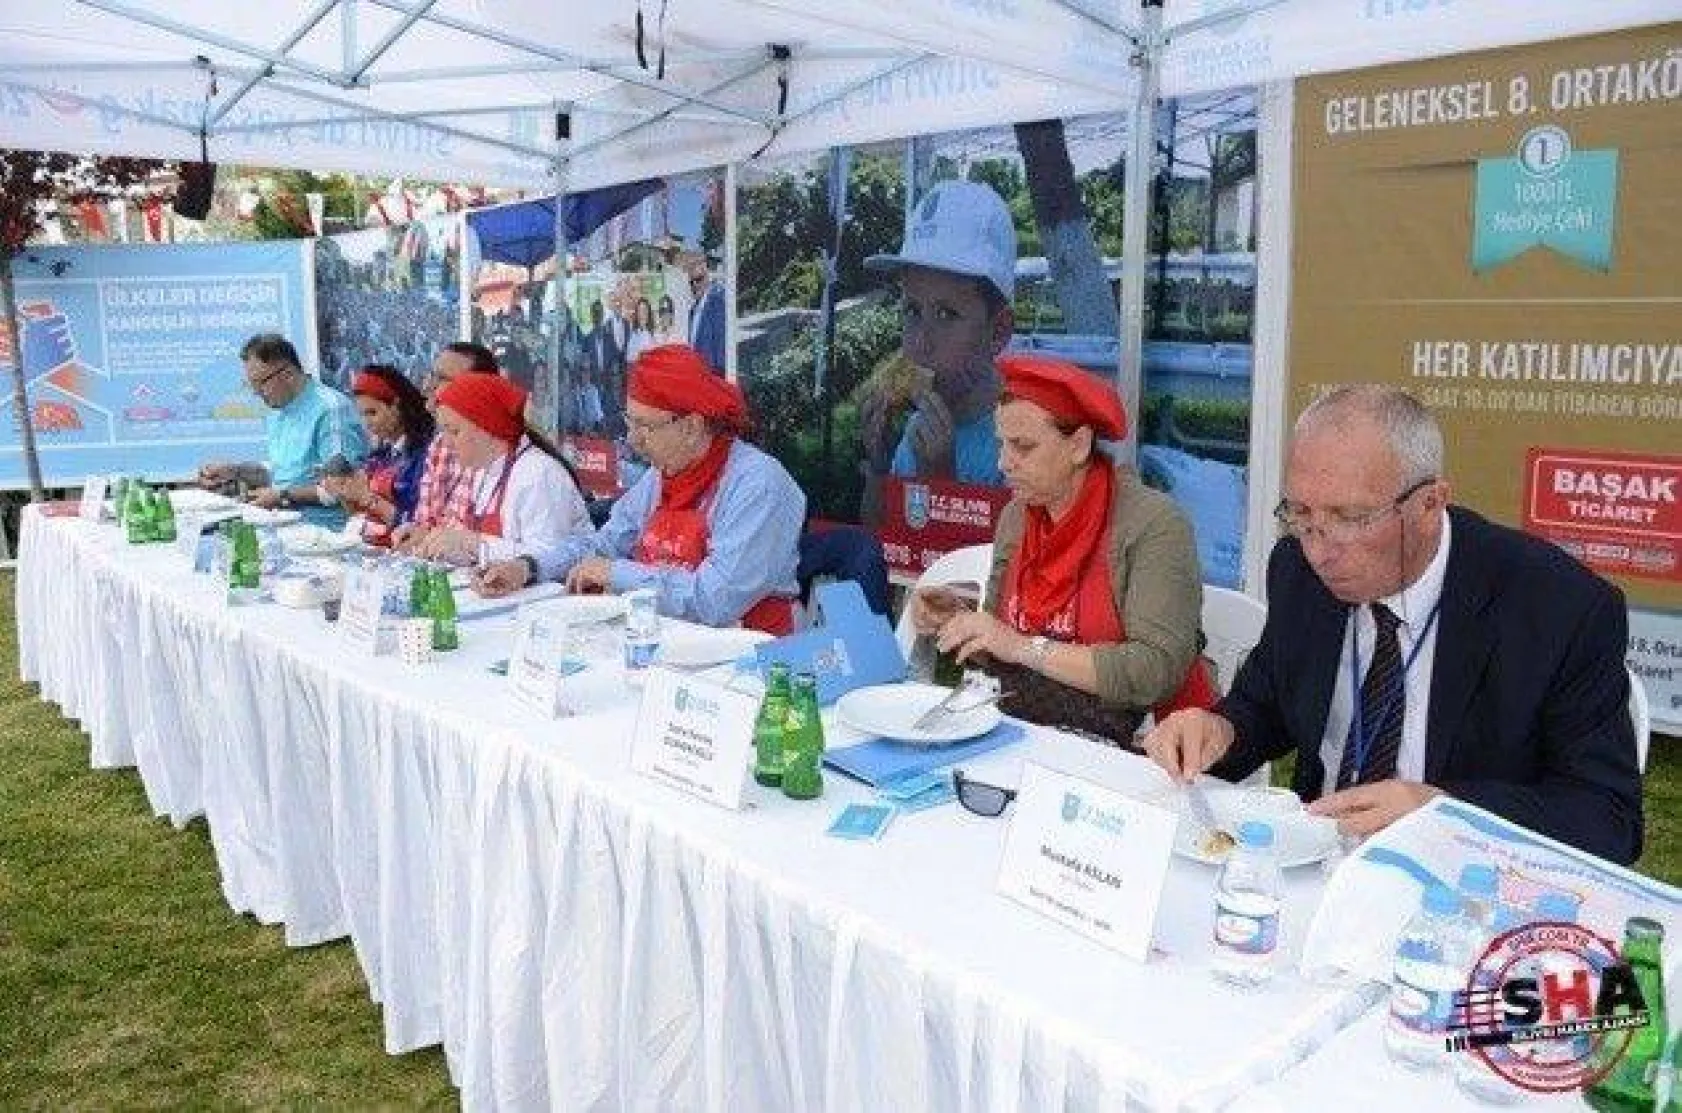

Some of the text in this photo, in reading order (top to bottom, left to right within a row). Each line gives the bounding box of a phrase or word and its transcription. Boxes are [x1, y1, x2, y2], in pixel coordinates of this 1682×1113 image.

[1325, 80, 1499, 134] GELENEKSEL
[1508, 76, 1537, 114] 8.
[1412, 340, 1469, 378] HER
[1553, 468, 1676, 502] BAŞAK
